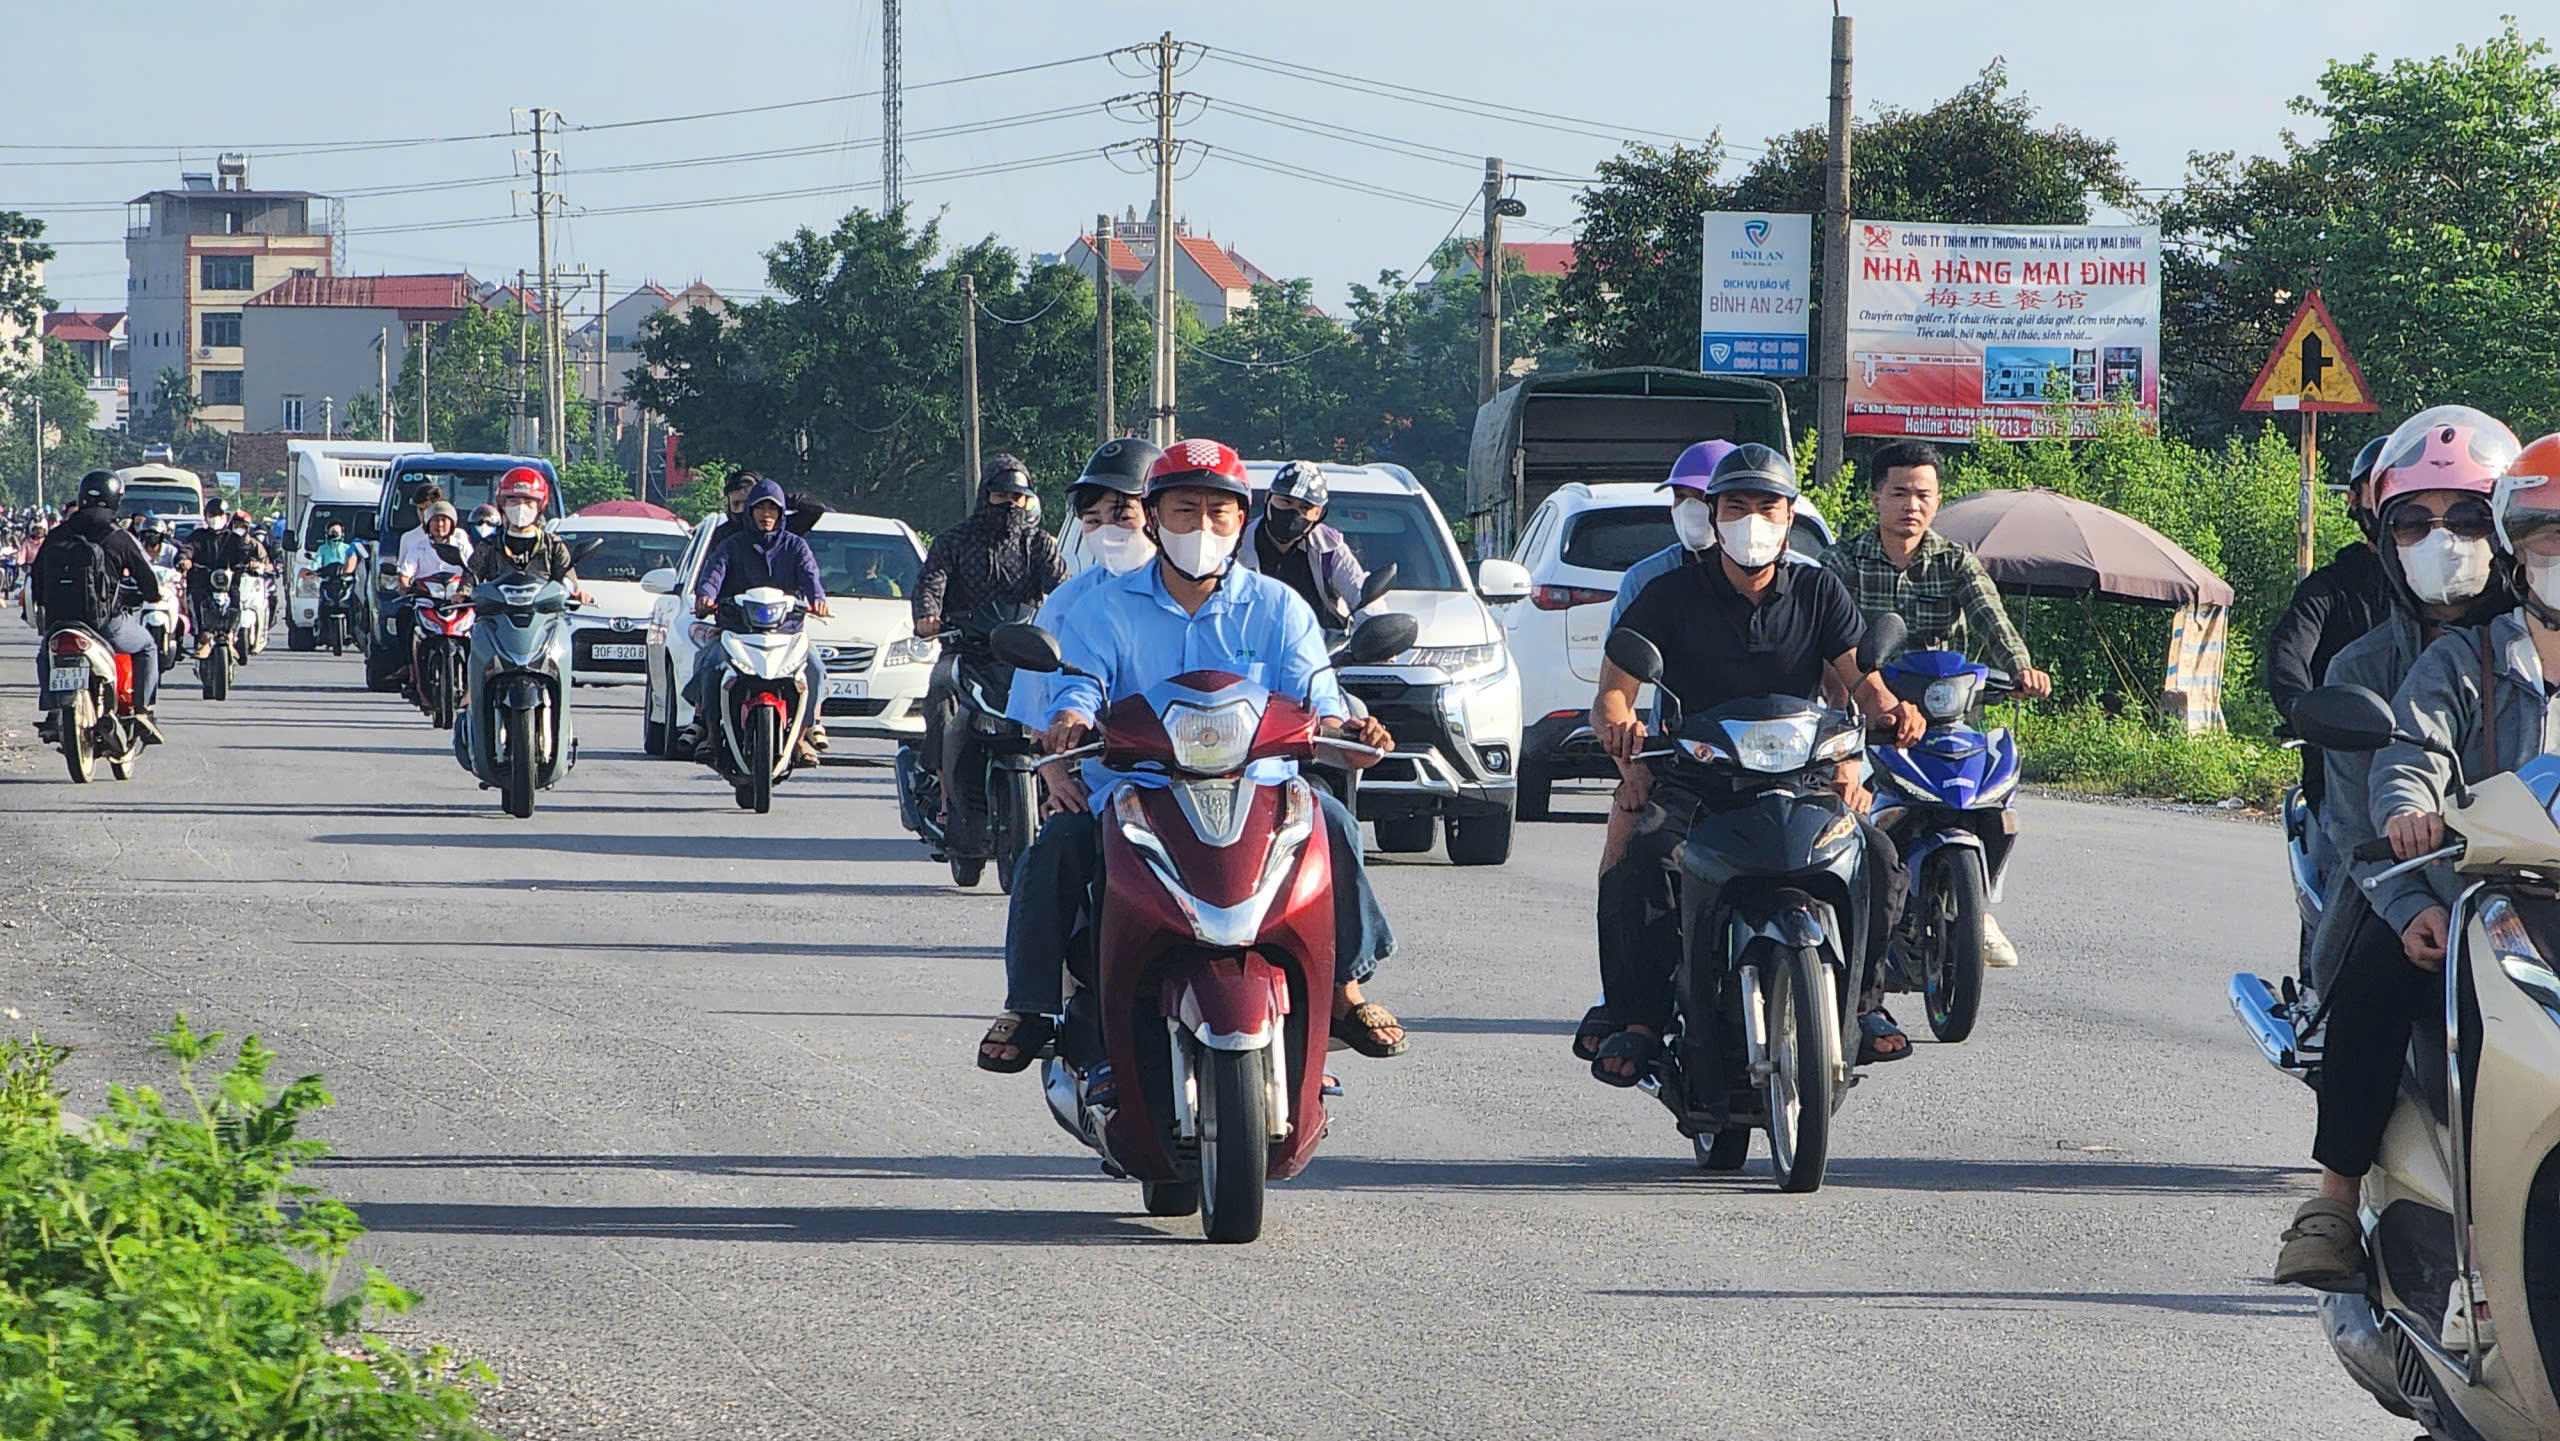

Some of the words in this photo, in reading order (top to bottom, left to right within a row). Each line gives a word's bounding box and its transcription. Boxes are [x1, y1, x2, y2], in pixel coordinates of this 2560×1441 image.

[1902, 231, 1927, 247] CÔNG
[1930, 234, 1941, 248] TY
[1943, 235, 1968, 249] TNHH
[1970, 236, 1990, 249] MTV
[1992, 236, 2027, 250] THƯƠNG
[2030, 237, 2048, 253] MẠI
[2049, 234, 2061, 250] VÀ
[2063, 237, 2085, 253] DỊCH
[2087, 237, 2098, 253] VỤ
[2100, 237, 2118, 249] MAI
[2120, 234, 2142, 250] ĐÌNH
[1766, 251, 1784, 260] AN
[1863, 252, 1922, 282] NHÀ
[1931, 254, 2012, 285] HÀNG
[2021, 261, 2070, 285] MAI
[2080, 255, 2146, 286] ĐÌNH
[1723, 279, 1744, 291] DỊCH
[1745, 279, 1758, 291] VỤ
[1709, 292, 1745, 313] BÌNH
[1750, 296, 1771, 313] AN
[1775, 297, 1804, 314] 247
[1905, 416, 1947, 434] Hotline:
